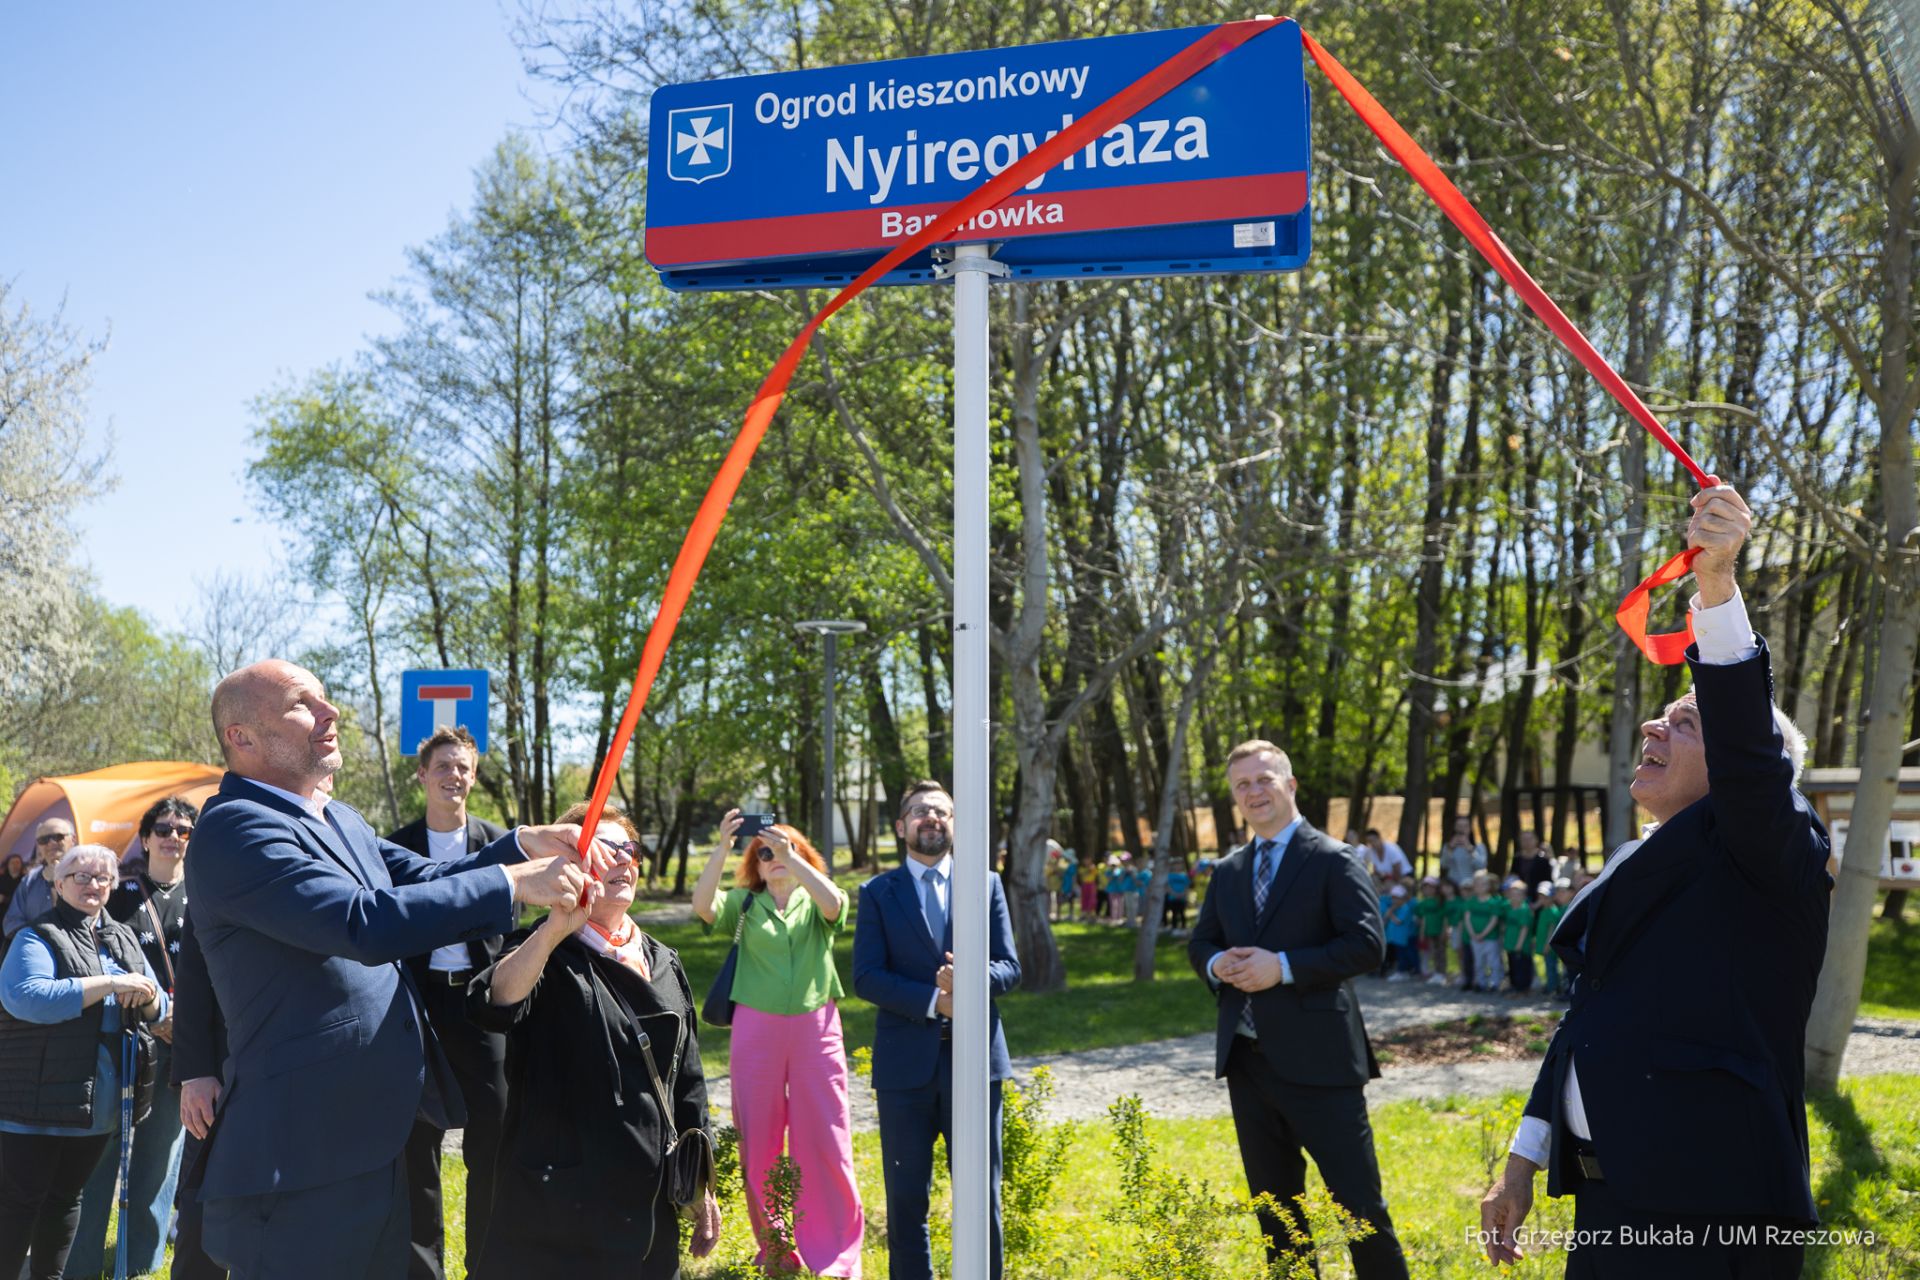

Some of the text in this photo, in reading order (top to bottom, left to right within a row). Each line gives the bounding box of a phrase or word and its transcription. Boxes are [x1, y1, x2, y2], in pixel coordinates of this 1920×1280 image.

[755, 66, 1090, 130] Ogrod kieszonkowy
[881, 200, 1064, 238] Barowka
